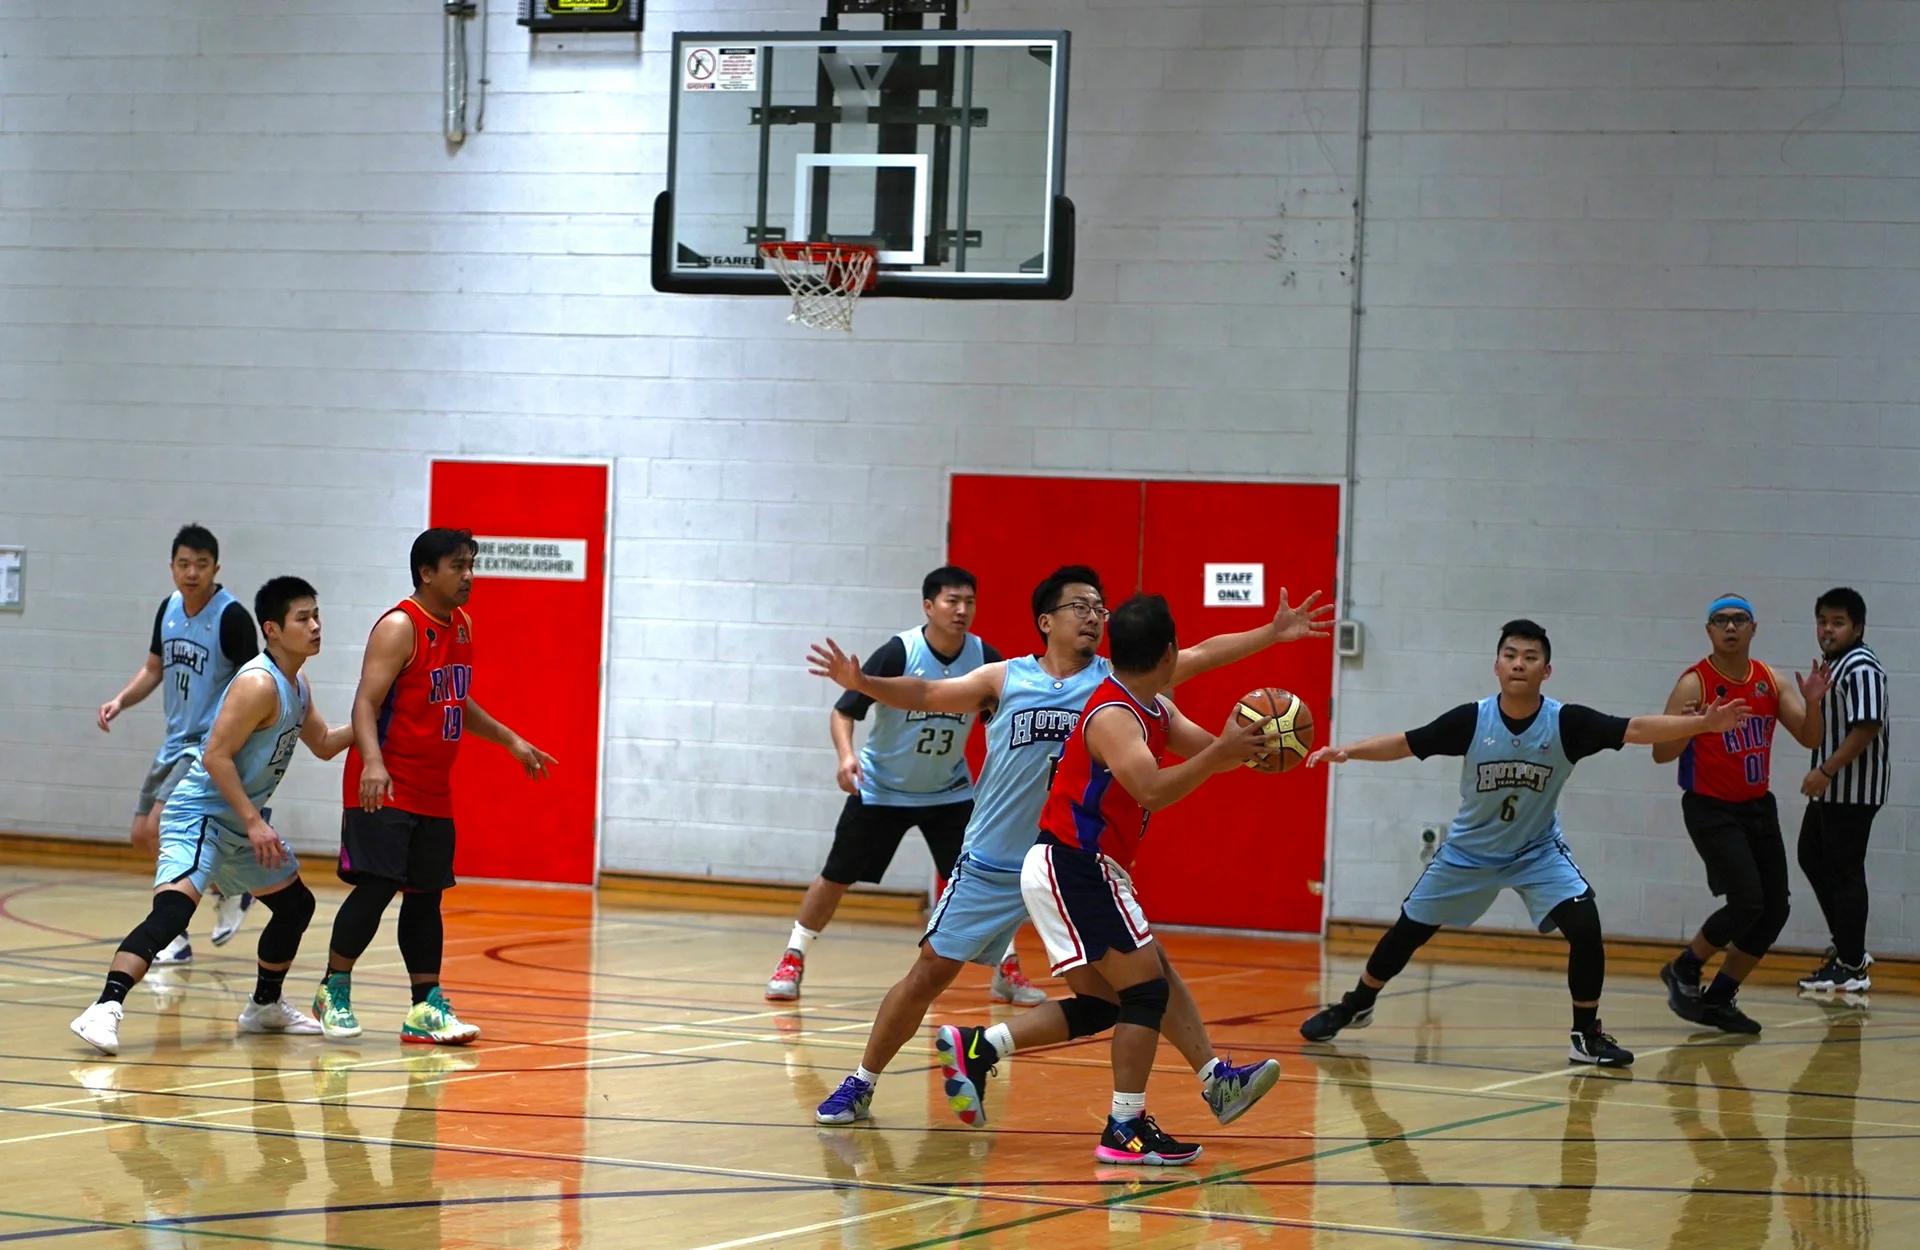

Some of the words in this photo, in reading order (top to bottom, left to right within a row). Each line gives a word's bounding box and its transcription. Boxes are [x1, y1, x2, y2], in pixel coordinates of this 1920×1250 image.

[498, 543, 530, 556] HOSE
[533, 544, 560, 557] REEL
[485, 558, 574, 573] EXTINGUISHER
[1216, 572, 1253, 584] STAFF
[1218, 589, 1251, 601] ONLY
[175, 671, 190, 701] 14
[443, 705, 463, 741] 19
[1010, 709, 1081, 747] HOTPO
[917, 727, 954, 756] 23
[1477, 761, 1553, 792] HOTPOT
[1501, 795, 1519, 822] 6
